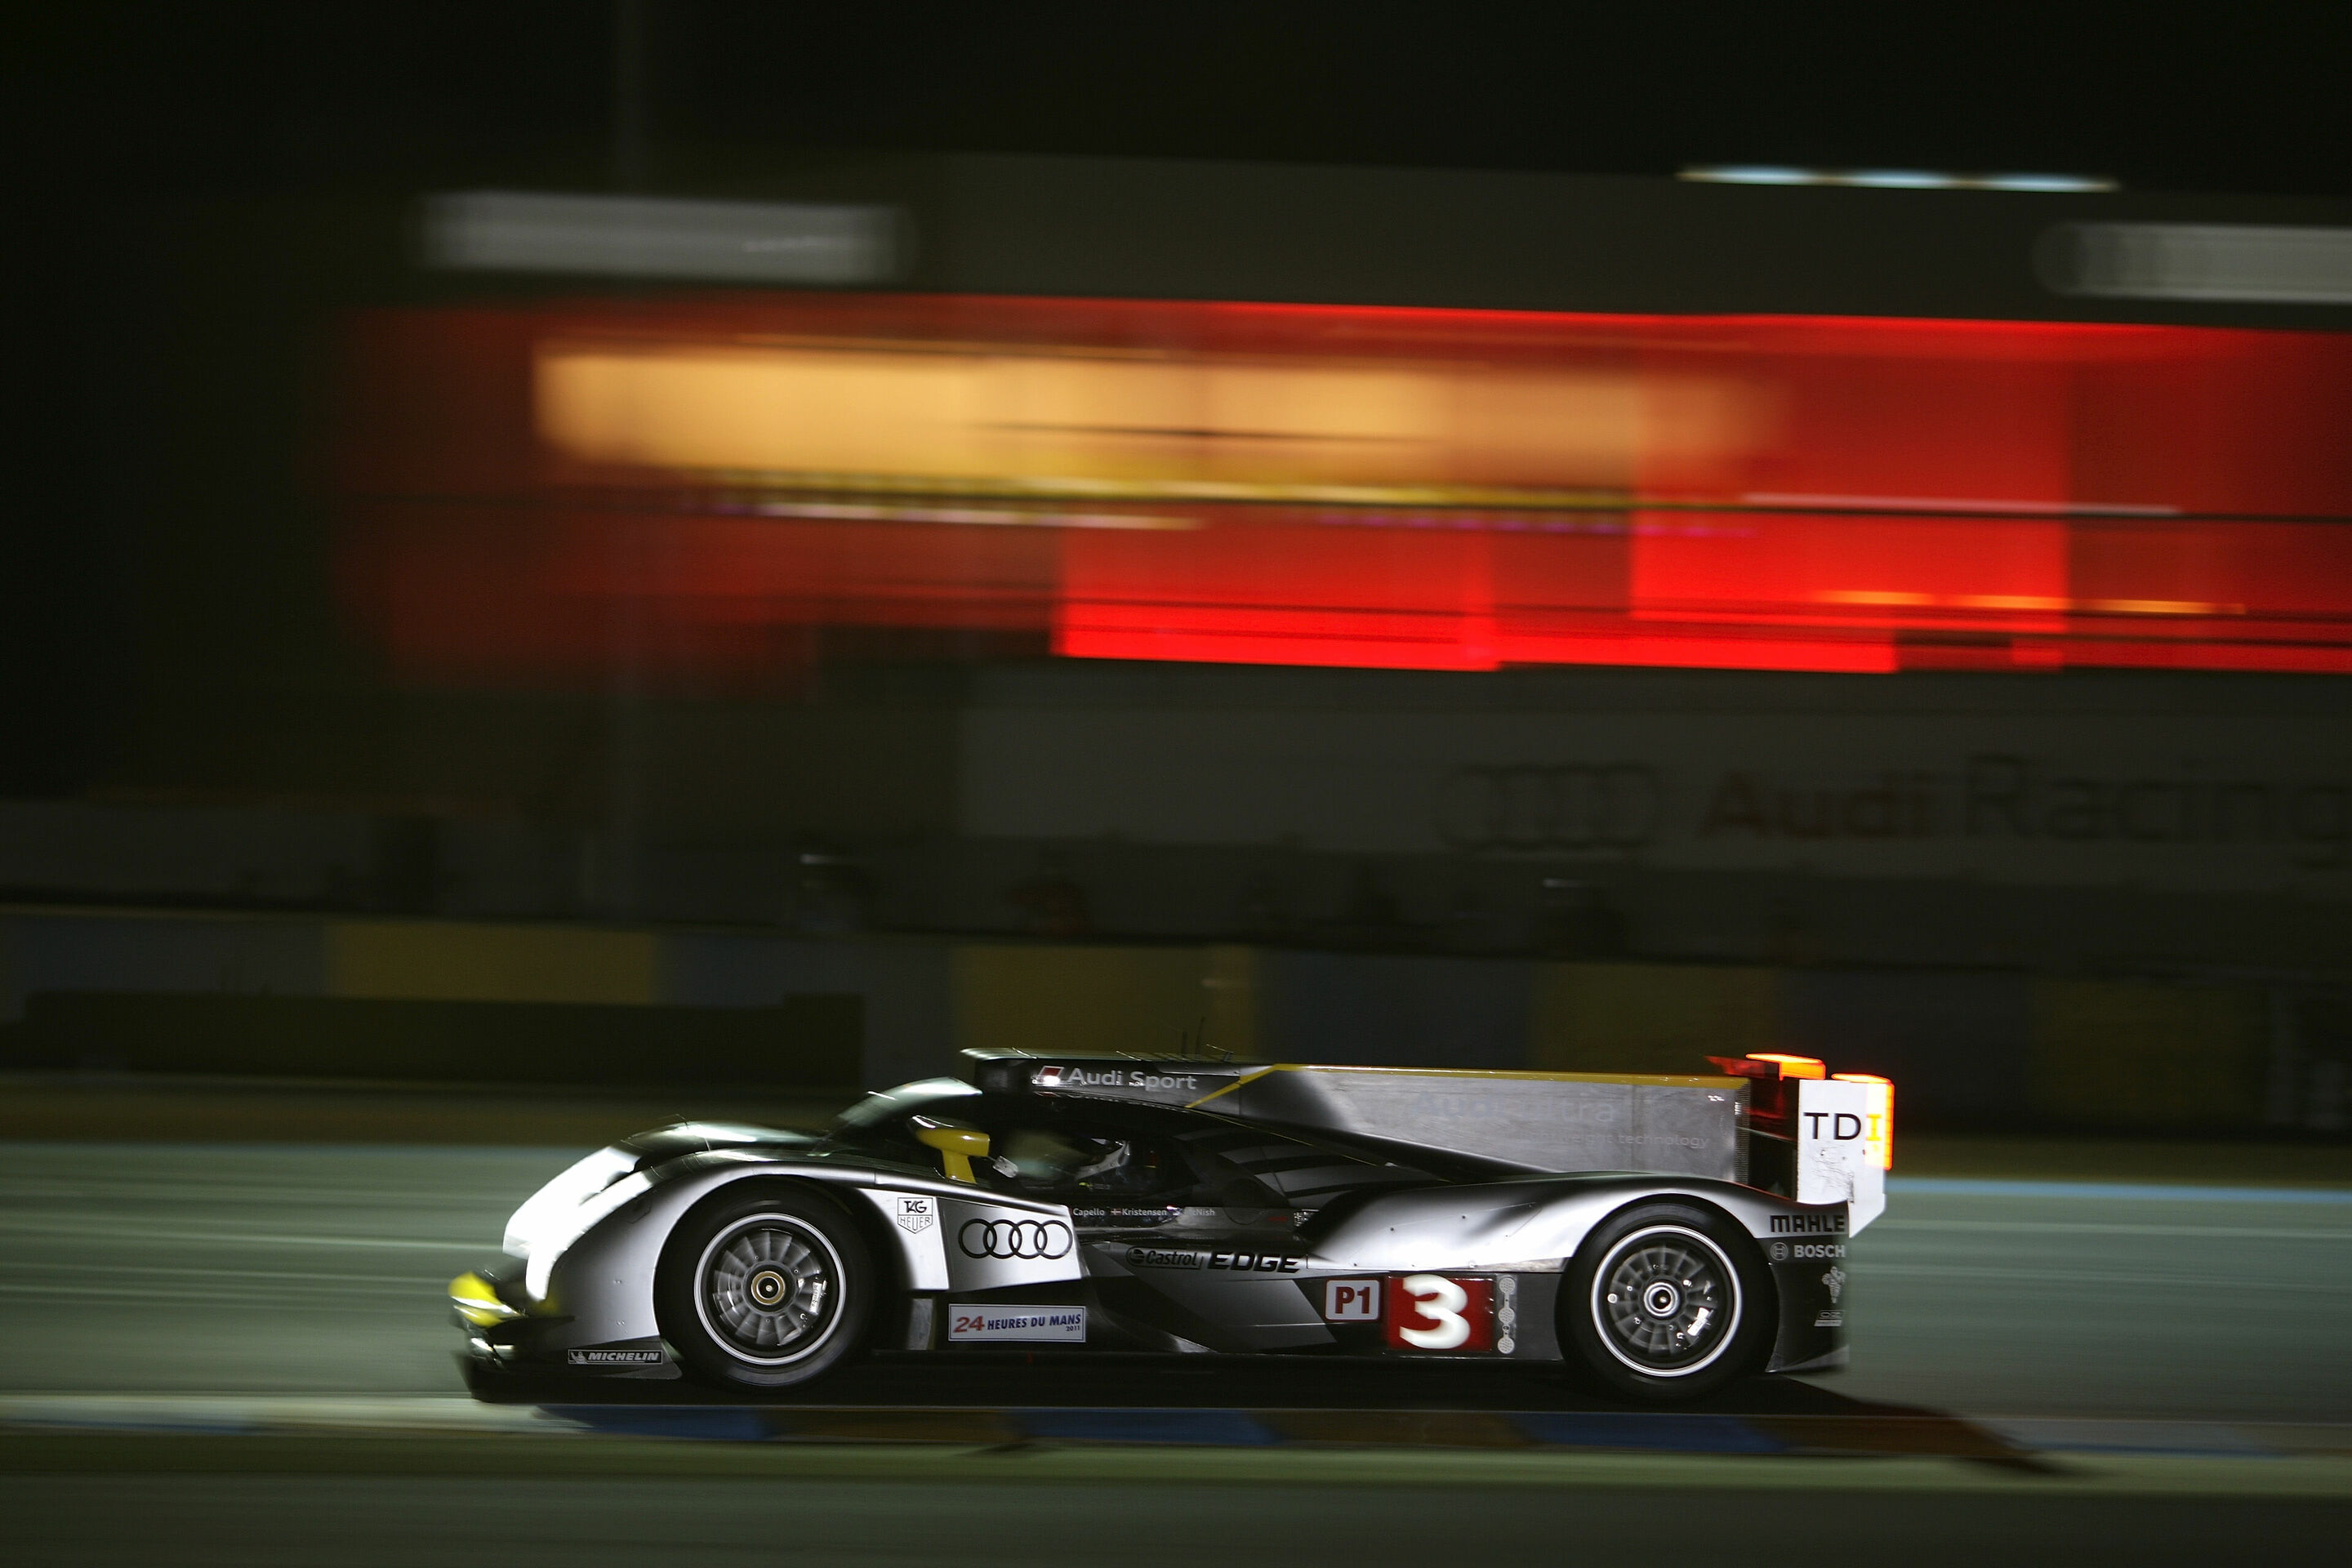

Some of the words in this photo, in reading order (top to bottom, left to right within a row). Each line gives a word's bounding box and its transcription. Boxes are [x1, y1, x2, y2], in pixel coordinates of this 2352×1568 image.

[1693, 768, 1934, 840] Audi
[1962, 752, 2352, 870] Racing
[1067, 1067, 1122, 1085] Audi
[1129, 1071, 1196, 1091] Sport
[1802, 1111, 1882, 1142] TDI
[1618, 1134, 1709, 1149] technology
[904, 1200, 928, 1214] TAG
[1072, 1209, 1105, 1218] Capello
[1122, 1208, 1167, 1216] Kristensen
[899, 1217, 931, 1232] HEUER
[1770, 1215, 1845, 1232] MAHLE
[1793, 1245, 1846, 1258] BOSCH
[1146, 1250, 1197, 1266] Castrol
[1208, 1251, 1302, 1273] EDGE
[1335, 1286, 1371, 1314] P1
[1399, 1274, 1471, 1349] 3
[953, 1316, 985, 1333] 24
[987, 1318, 1027, 1330] HEURES
[1031, 1316, 1046, 1327] DU
[1049, 1314, 1081, 1325] MANS
[587, 1352, 659, 1361] MICHELIN
